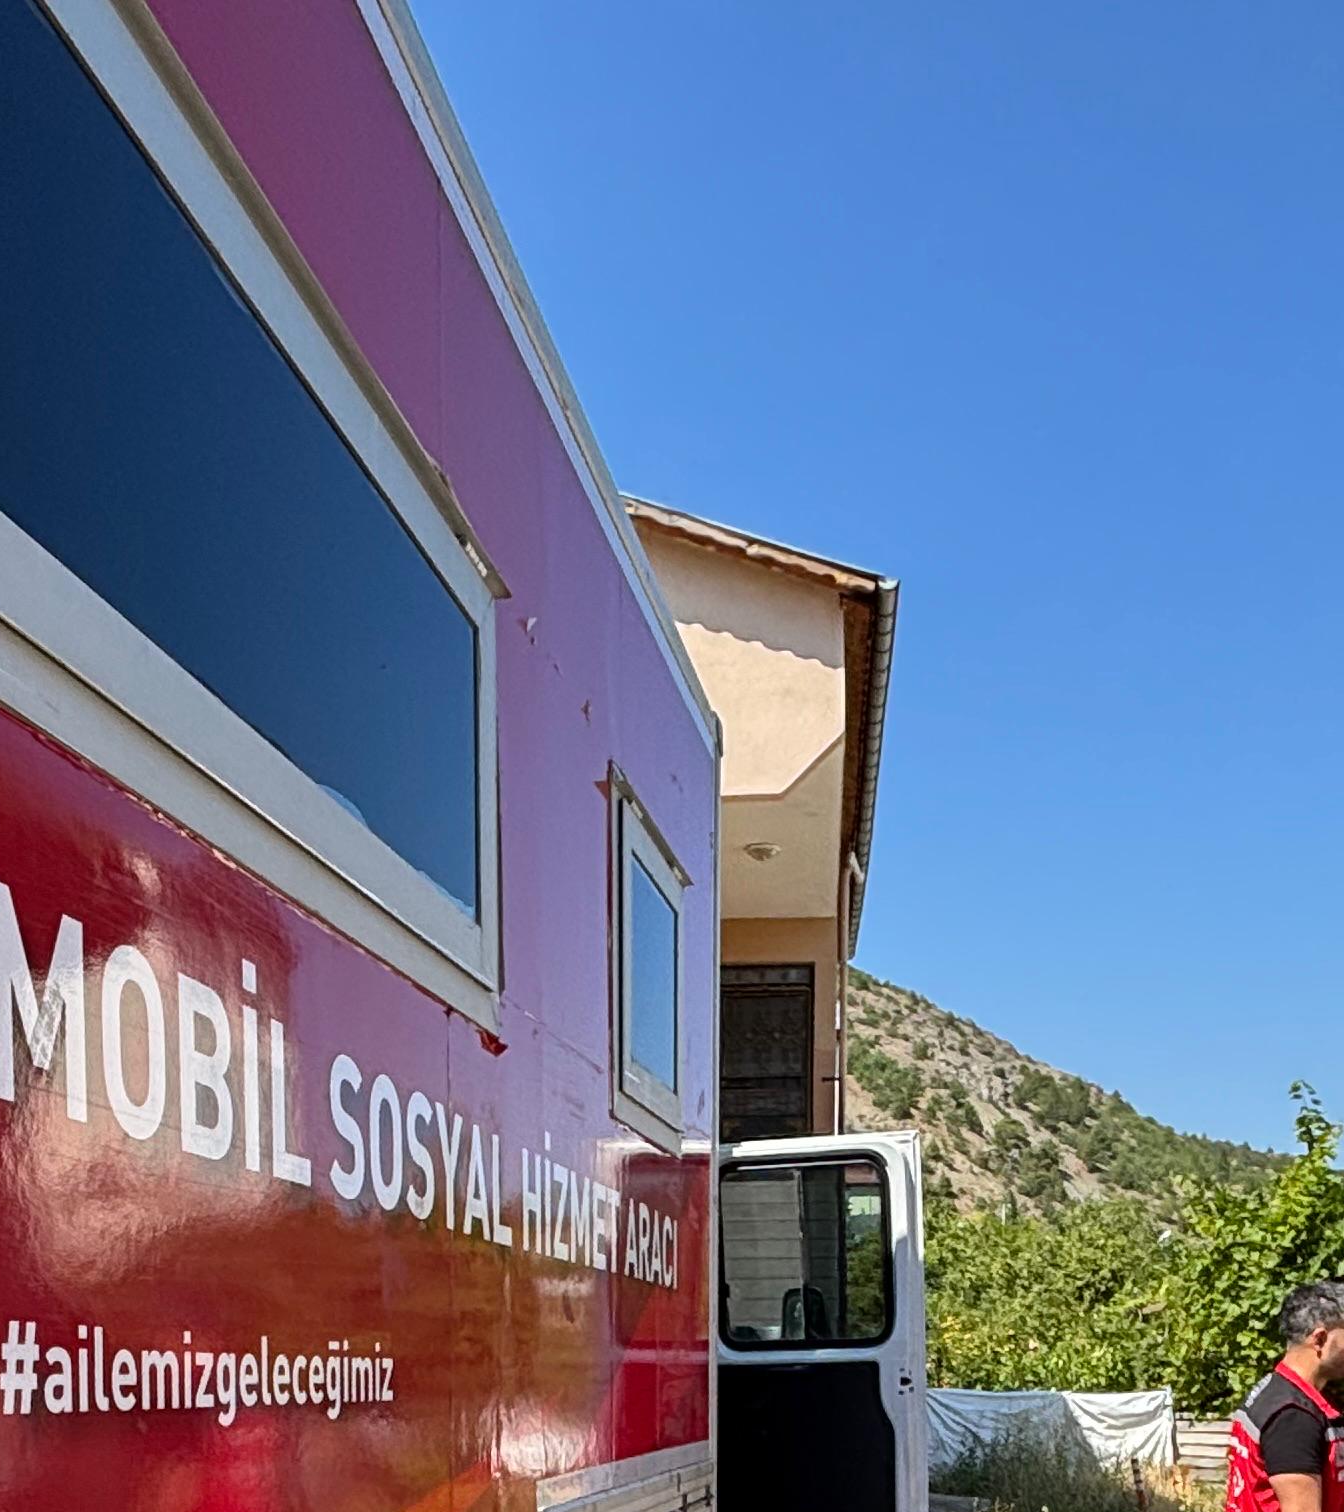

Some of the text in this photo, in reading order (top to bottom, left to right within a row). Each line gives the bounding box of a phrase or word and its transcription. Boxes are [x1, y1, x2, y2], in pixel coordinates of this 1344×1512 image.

[329, 1053, 512, 1247] SOSYAL
[522, 1131, 621, 1272] HİZMET
[624, 1198, 678, 1289] ARACI
[0, 1320, 394, 1427] #ailemizgeleceğimiz
